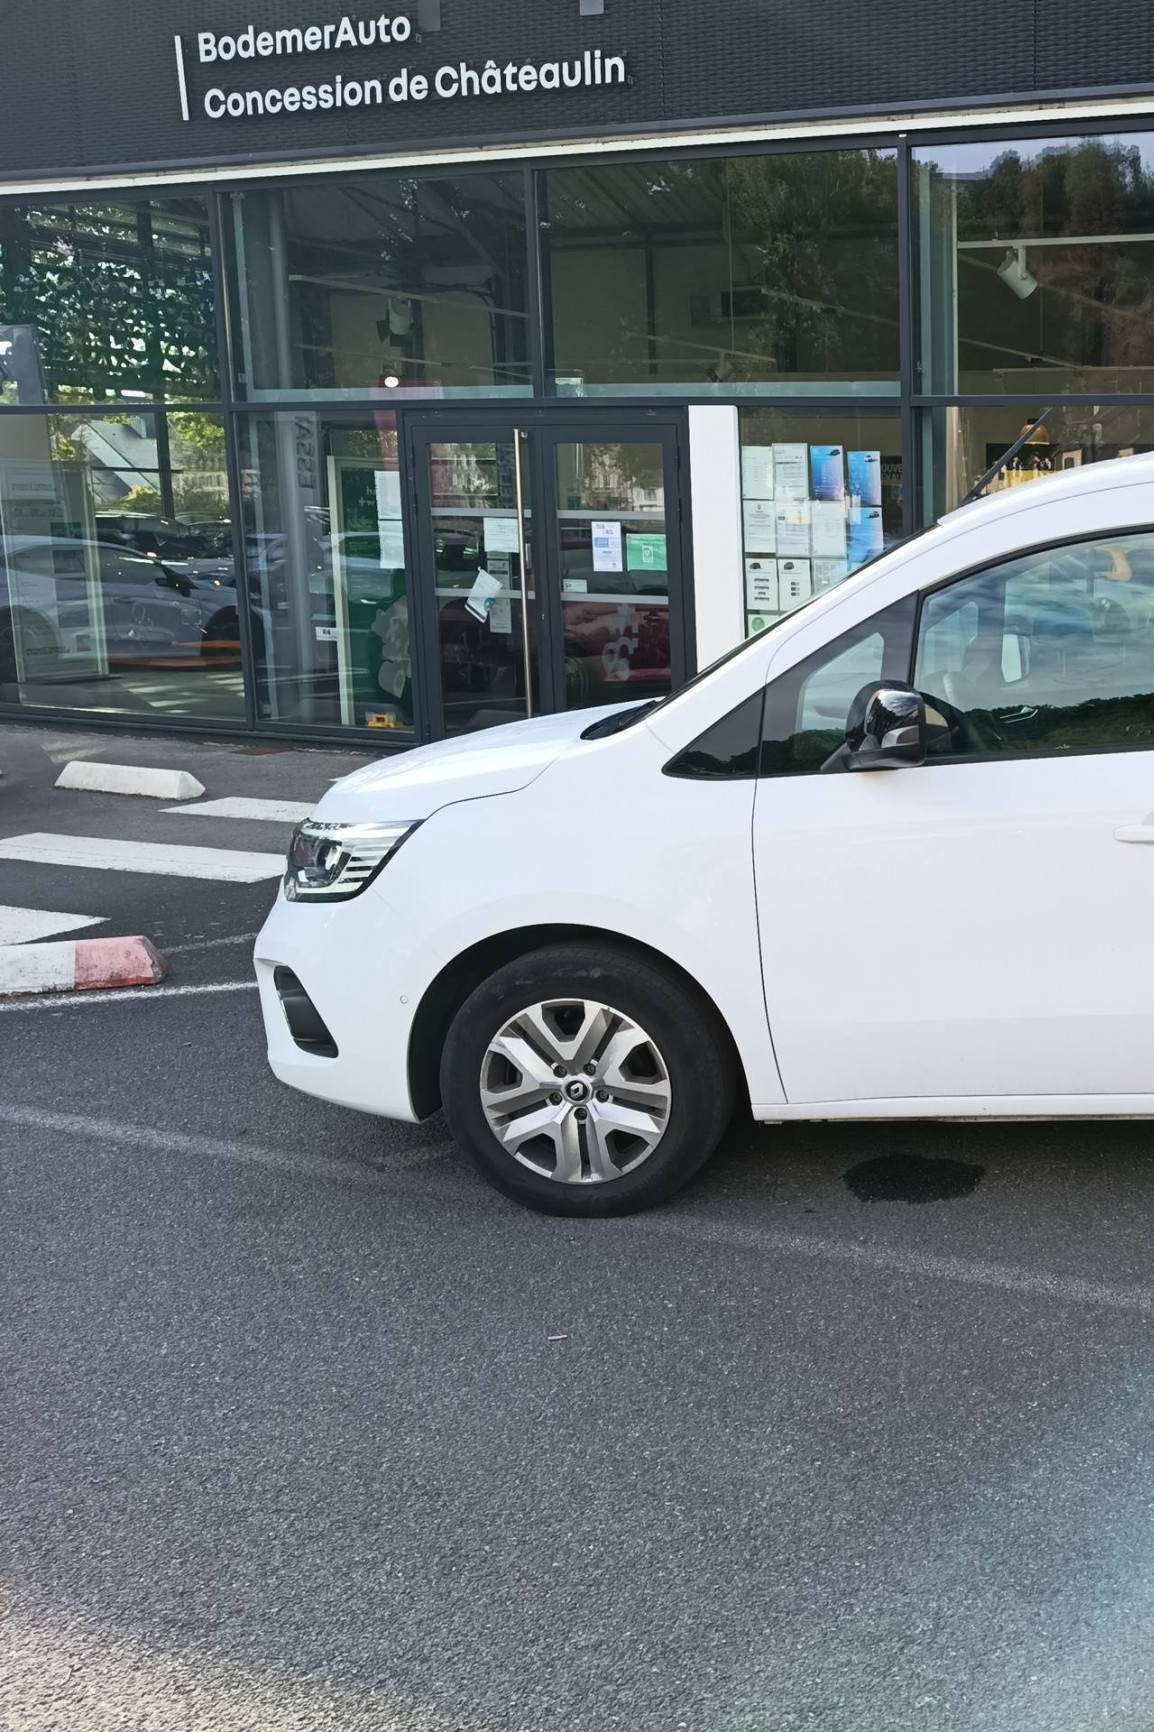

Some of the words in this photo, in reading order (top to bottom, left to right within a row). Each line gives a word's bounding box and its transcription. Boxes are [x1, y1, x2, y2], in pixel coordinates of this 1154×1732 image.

[198, 14, 411, 63] BodemerAuto
[204, 74, 382, 119] Concession
[388, 67, 429, 102] de
[435, 49, 625, 98] Châteaulin
